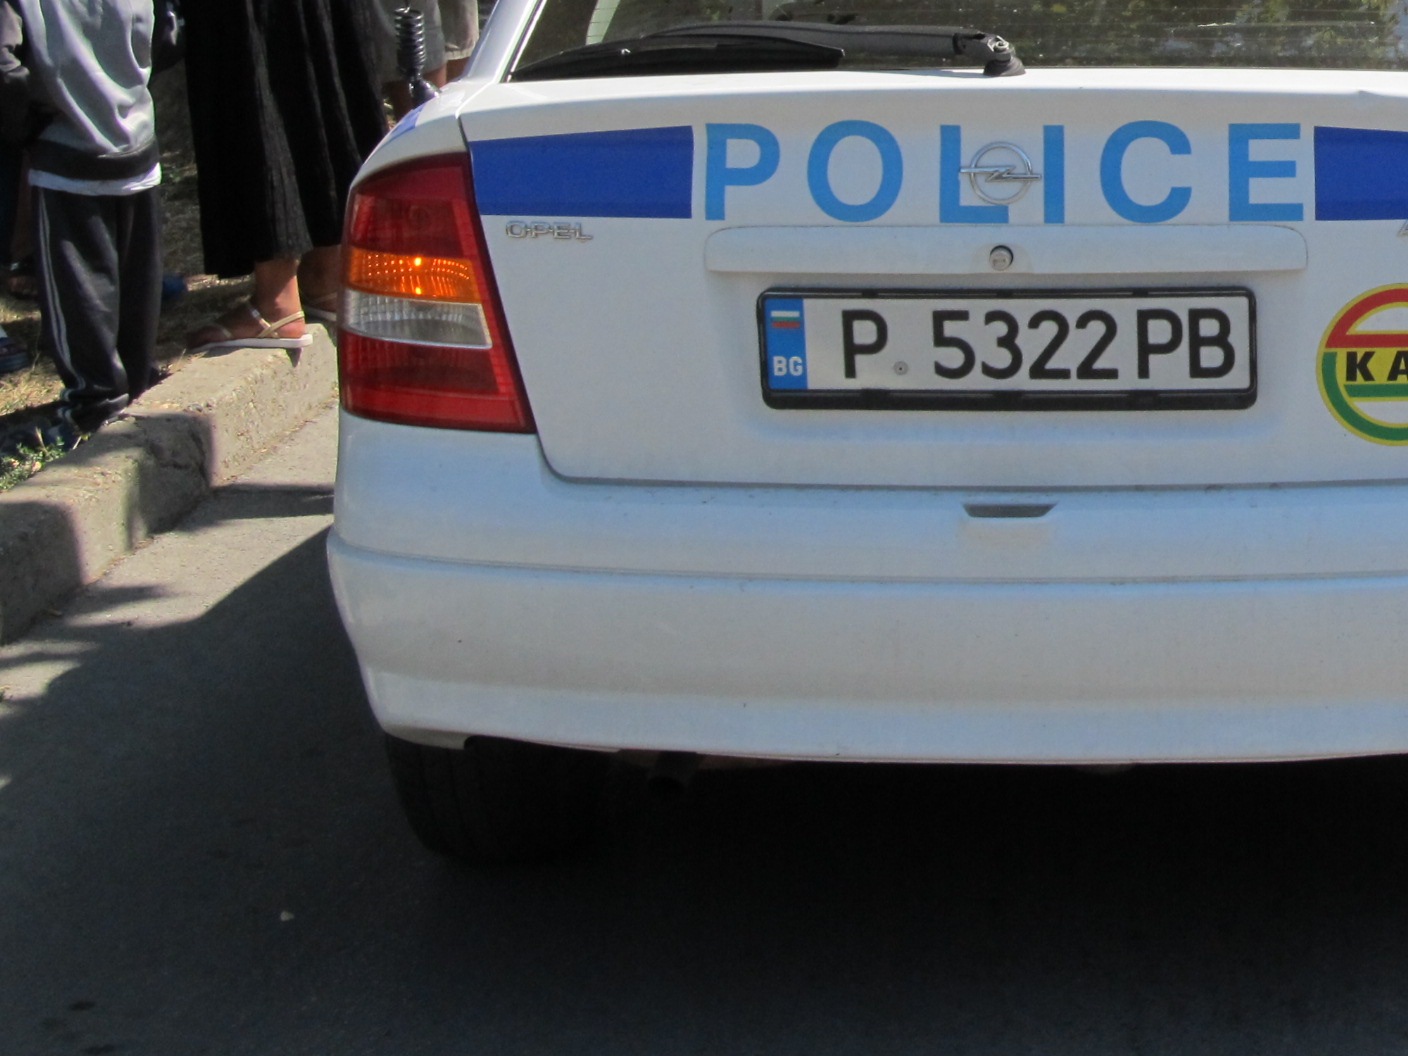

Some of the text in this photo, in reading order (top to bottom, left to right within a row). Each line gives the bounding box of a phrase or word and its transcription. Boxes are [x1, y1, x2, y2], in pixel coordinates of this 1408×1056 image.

[705, 120, 1304, 223] POLICE
[506, 220, 594, 241] OPEL
[773, 355, 804, 377] BG
[841, 308, 1236, 380] P 5322 PB
